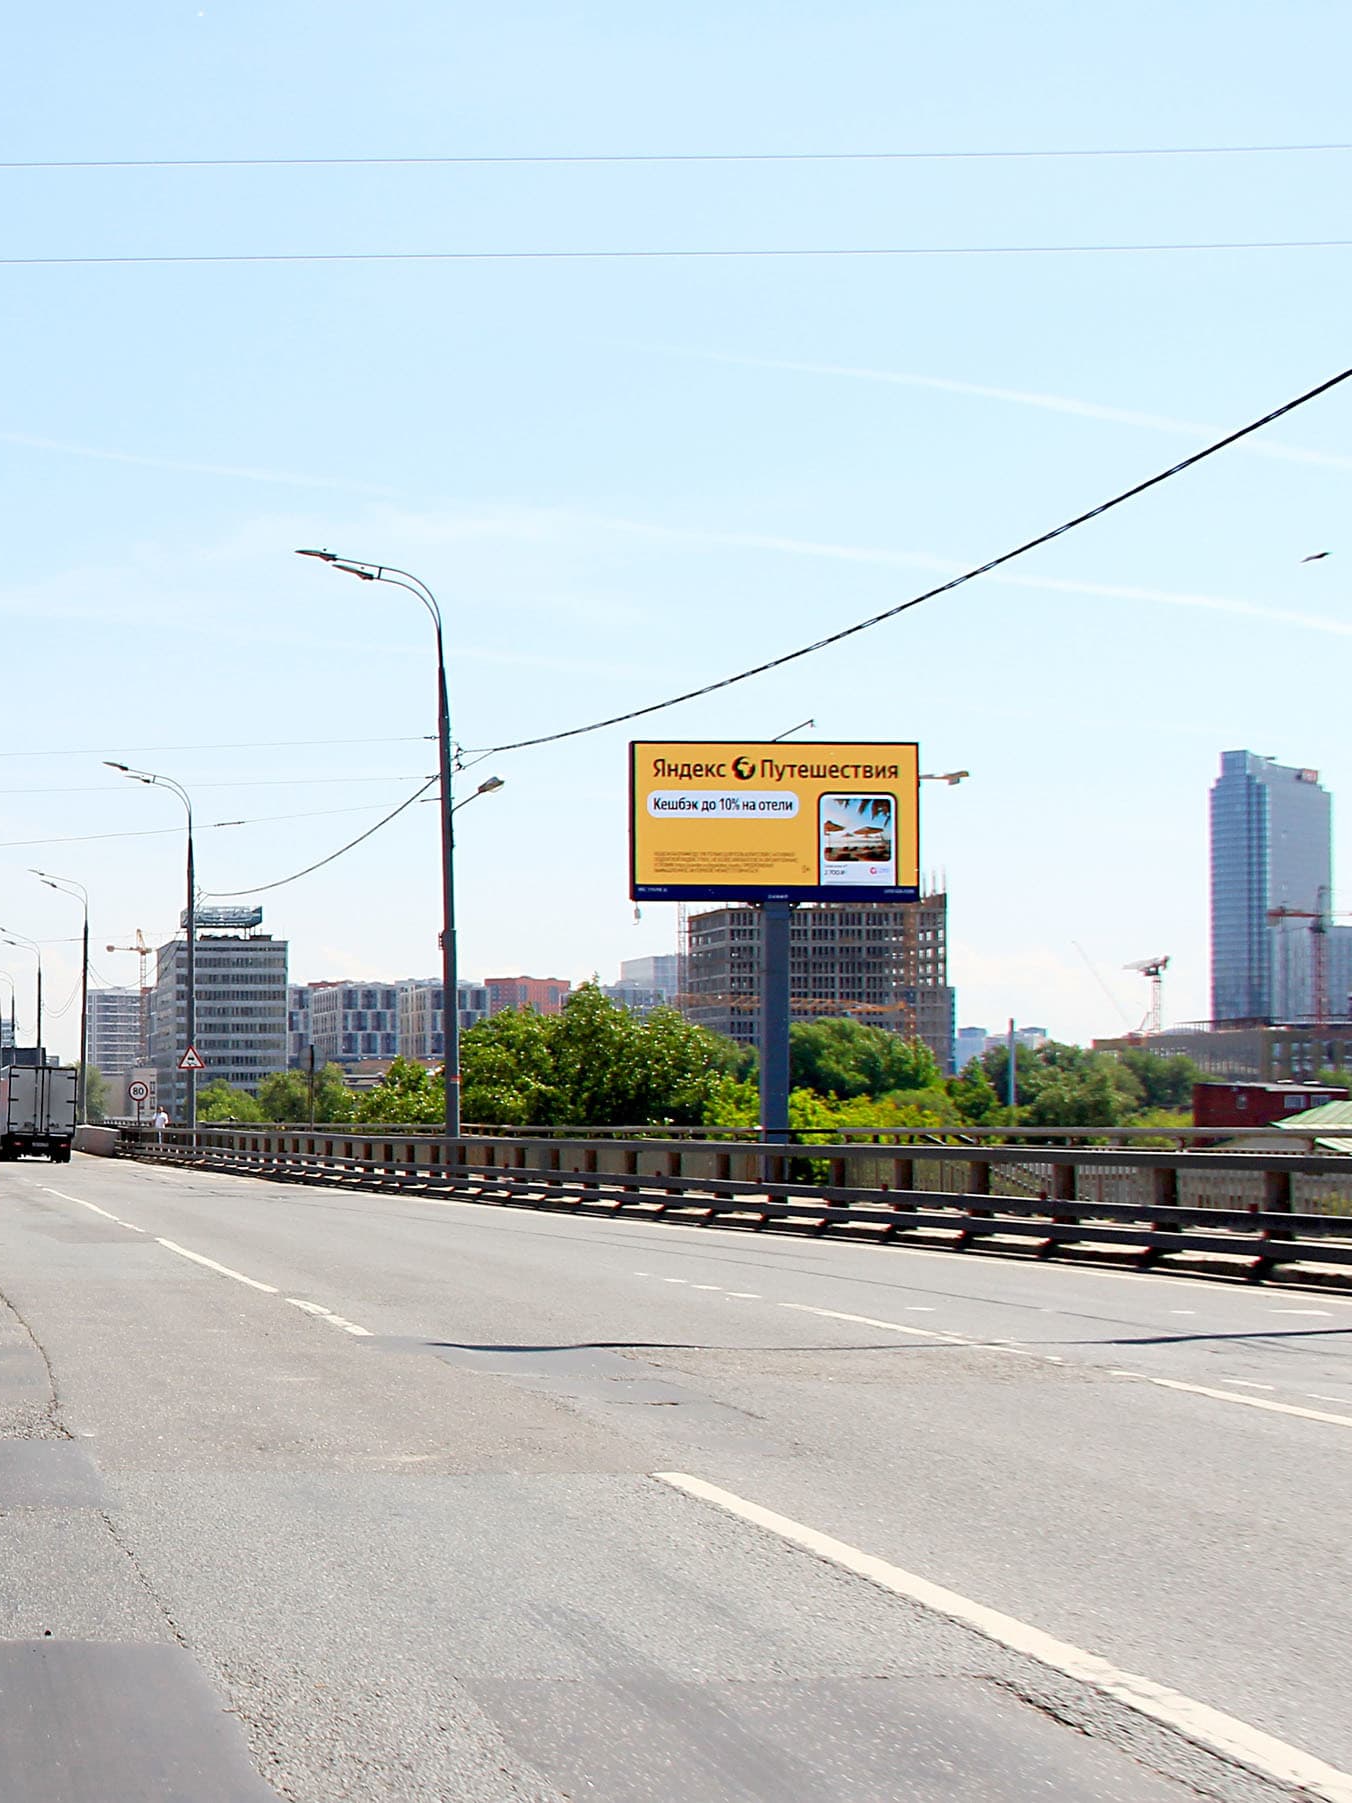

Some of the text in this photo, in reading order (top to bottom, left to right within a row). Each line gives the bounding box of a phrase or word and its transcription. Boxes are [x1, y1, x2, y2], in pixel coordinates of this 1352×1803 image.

[652, 758, 899, 782] Яндекс Путешествия
[653, 797, 794, 812] Кешбэк до 10% на отели
[132, 1086, 145, 1097] 80
